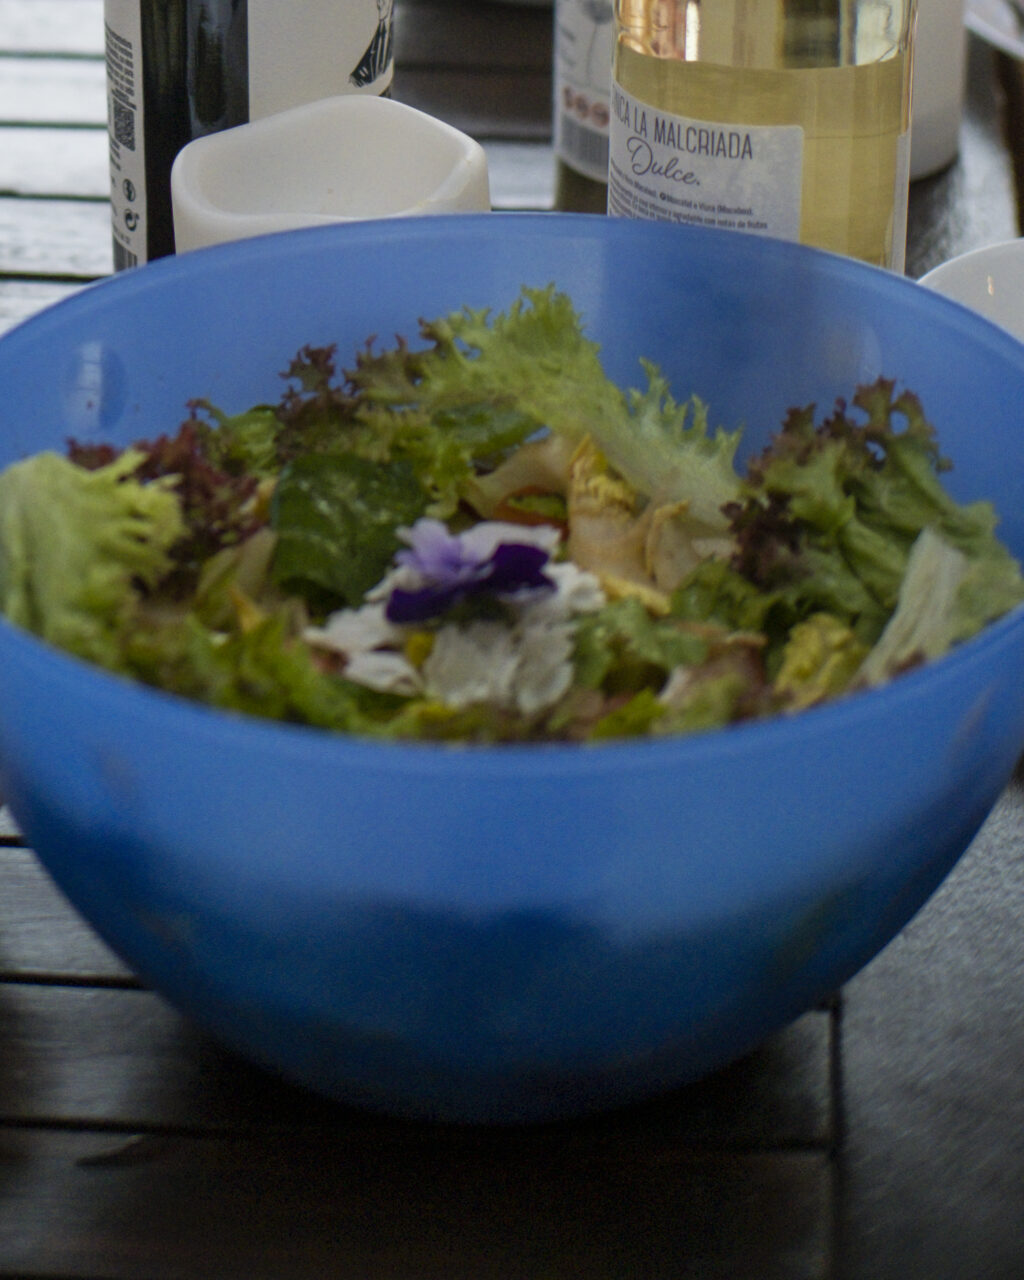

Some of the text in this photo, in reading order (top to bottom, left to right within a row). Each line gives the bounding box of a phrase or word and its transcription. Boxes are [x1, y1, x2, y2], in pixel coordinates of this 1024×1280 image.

[634, 105, 648, 139] LA
[654, 116, 753, 160] MALCRIADA
[626, 136, 700, 186] Dulce.
